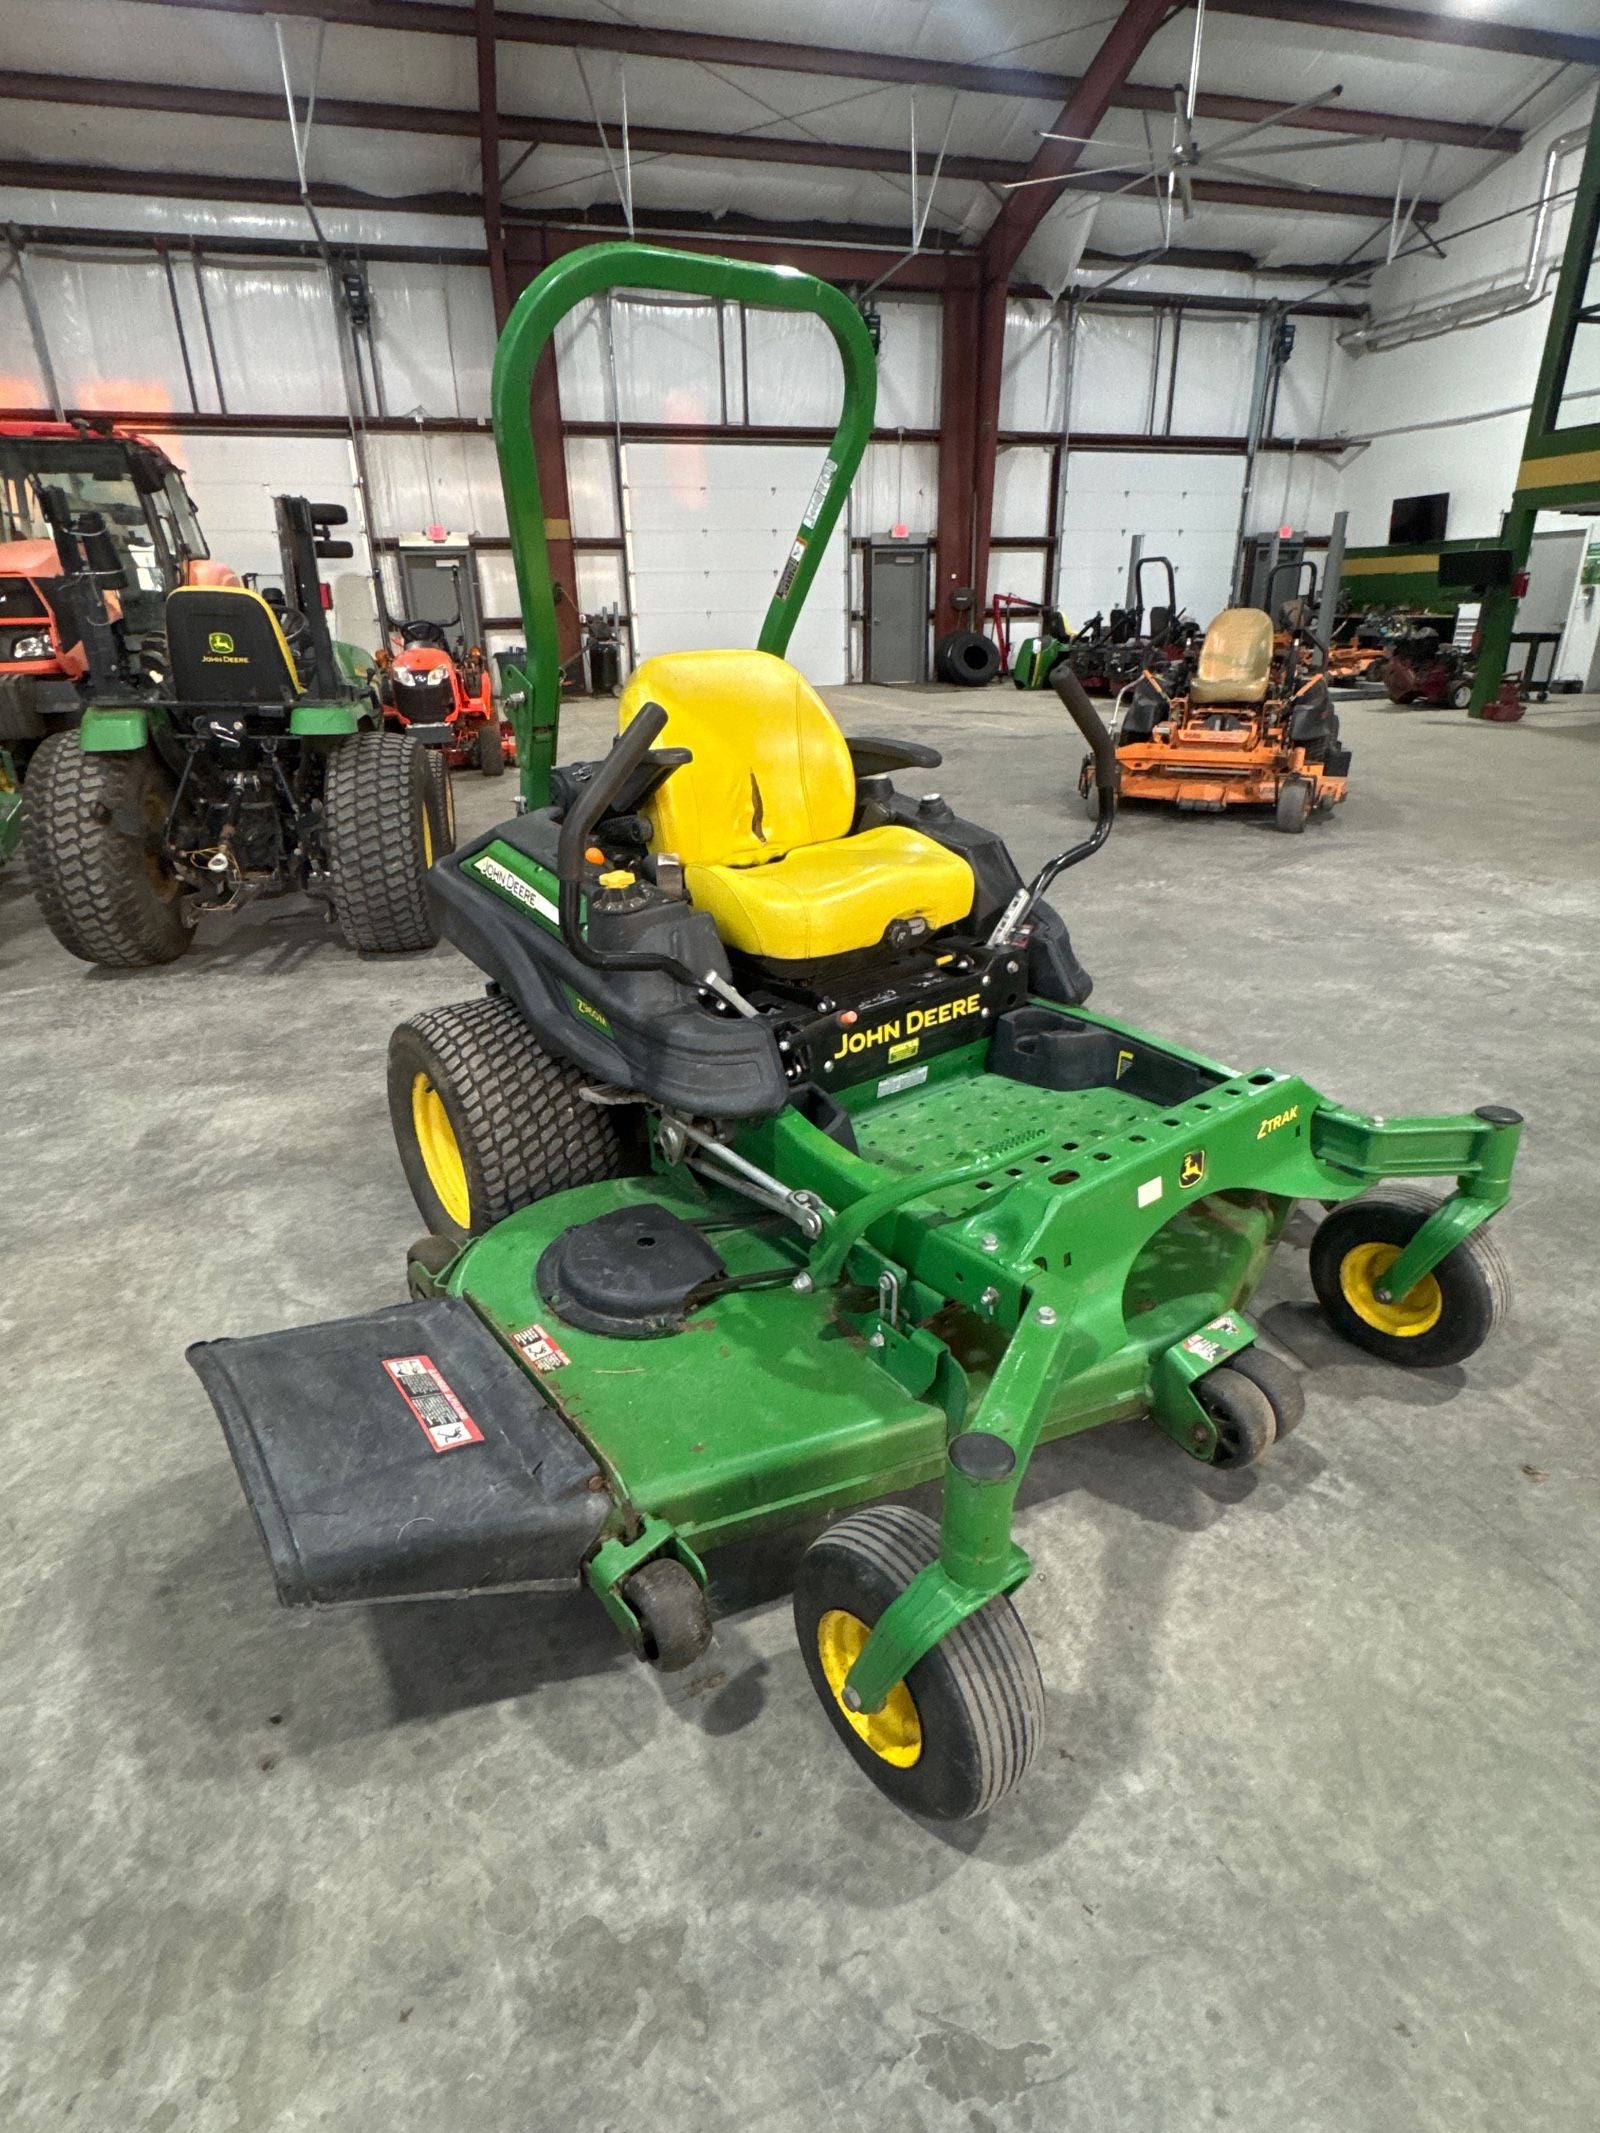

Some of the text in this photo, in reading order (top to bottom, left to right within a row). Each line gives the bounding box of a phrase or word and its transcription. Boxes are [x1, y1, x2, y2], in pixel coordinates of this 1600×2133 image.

[482, 861, 537, 906] JOHN DEERE
[834, 1020, 900, 1060] JOHN
[906, 993, 981, 1035] DEERE
[1256, 1104, 1298, 1140] ZTRAK
